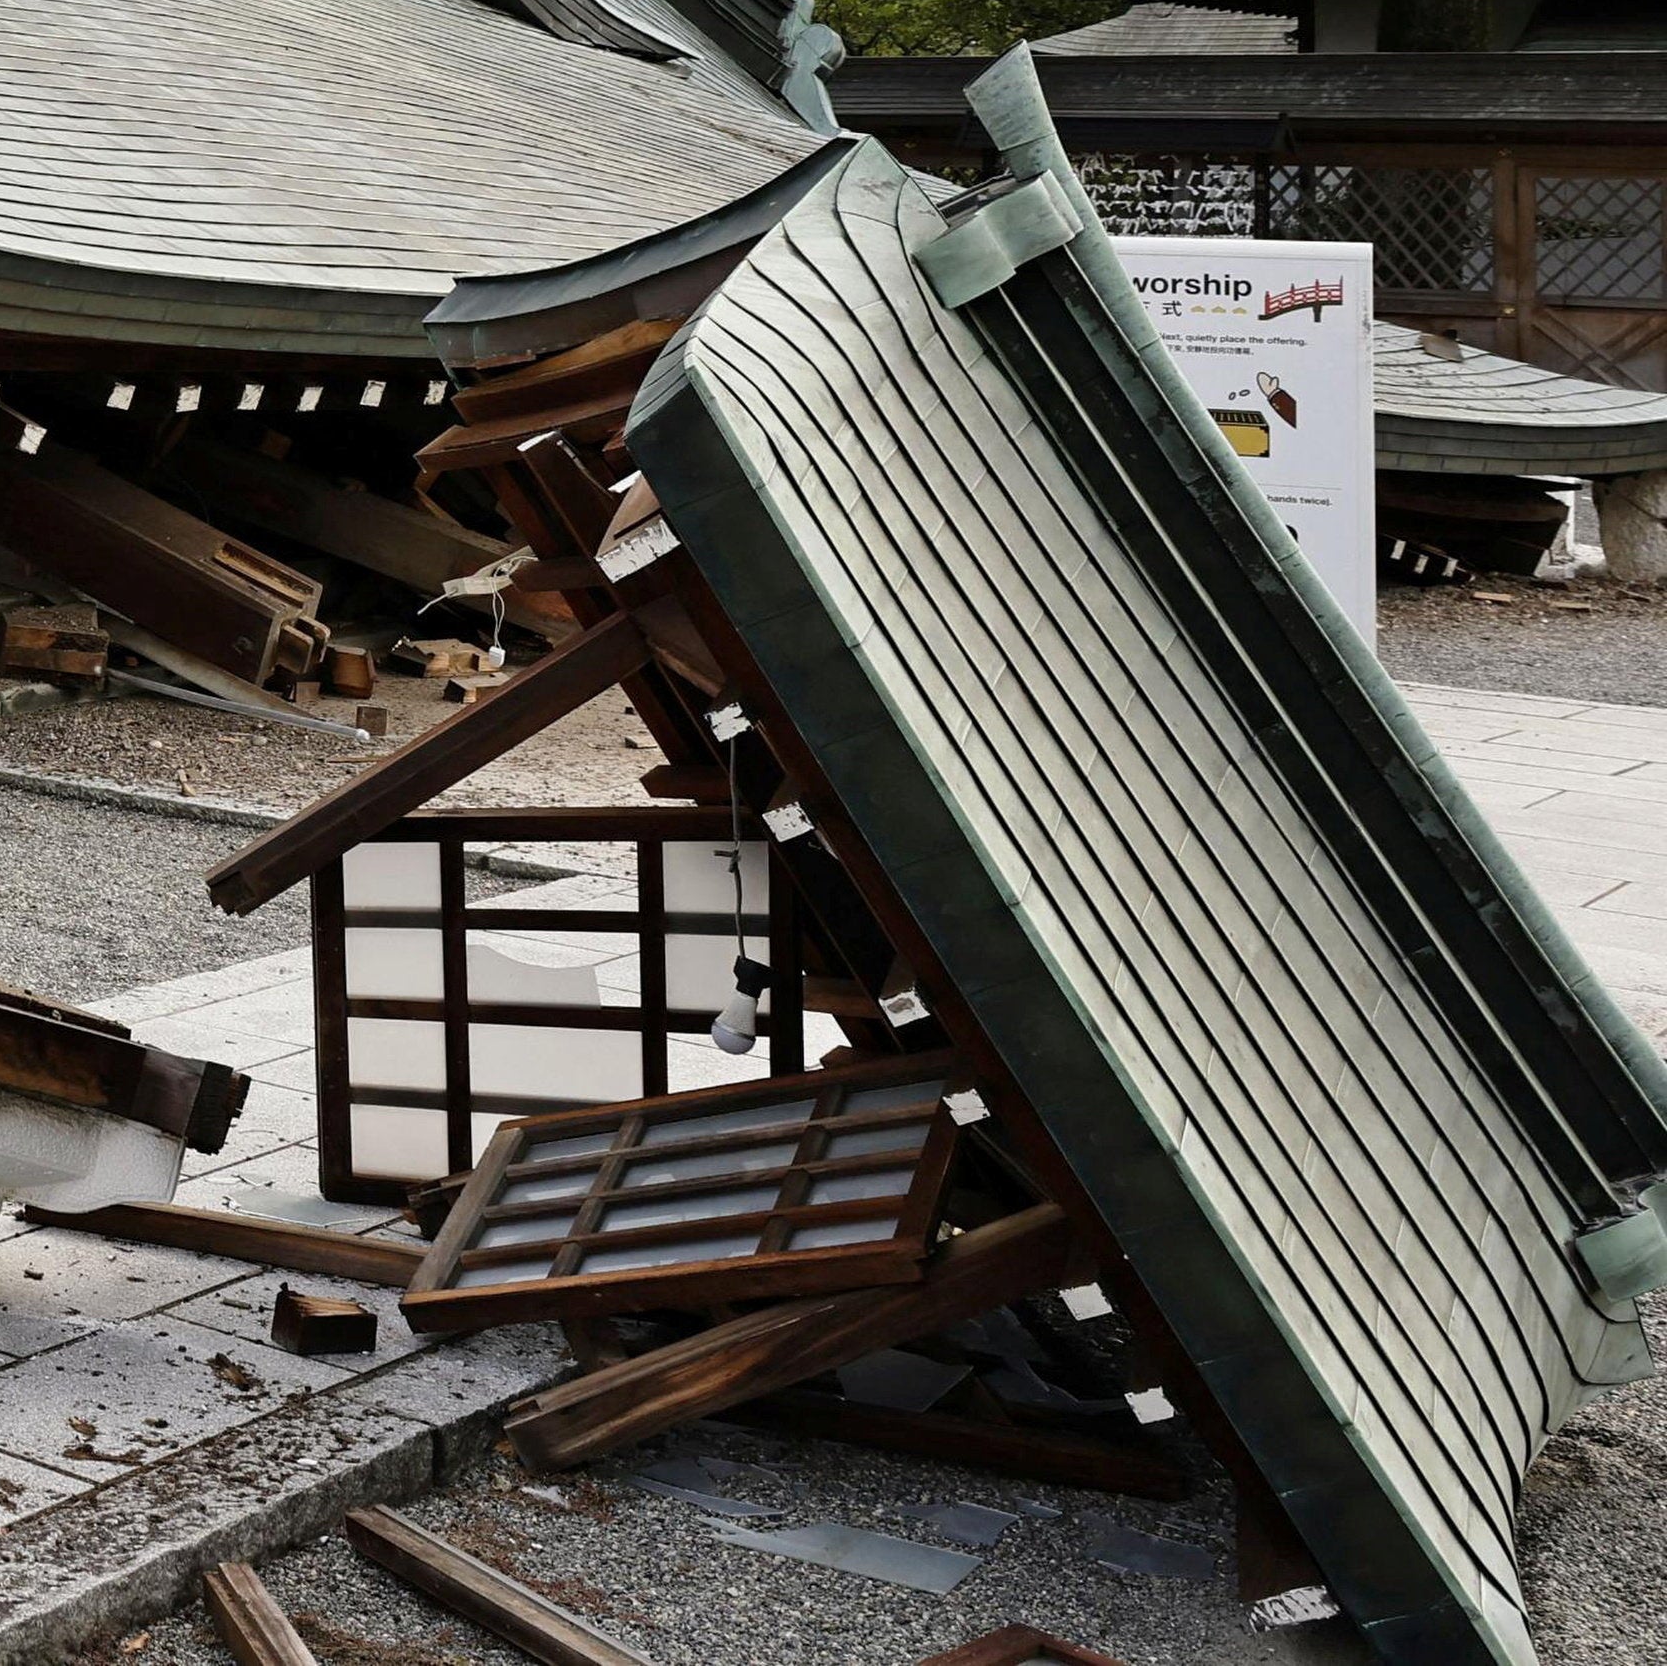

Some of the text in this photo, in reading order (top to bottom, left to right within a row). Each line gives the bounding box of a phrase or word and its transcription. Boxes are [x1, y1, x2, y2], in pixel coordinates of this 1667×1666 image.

[1133, 273, 1252, 301] worship
[1186, 334, 1217, 344] quietly
[1219, 335, 1247, 344] place
[1248, 336, 1265, 344] the
[1267, 494, 1298, 504] hands
